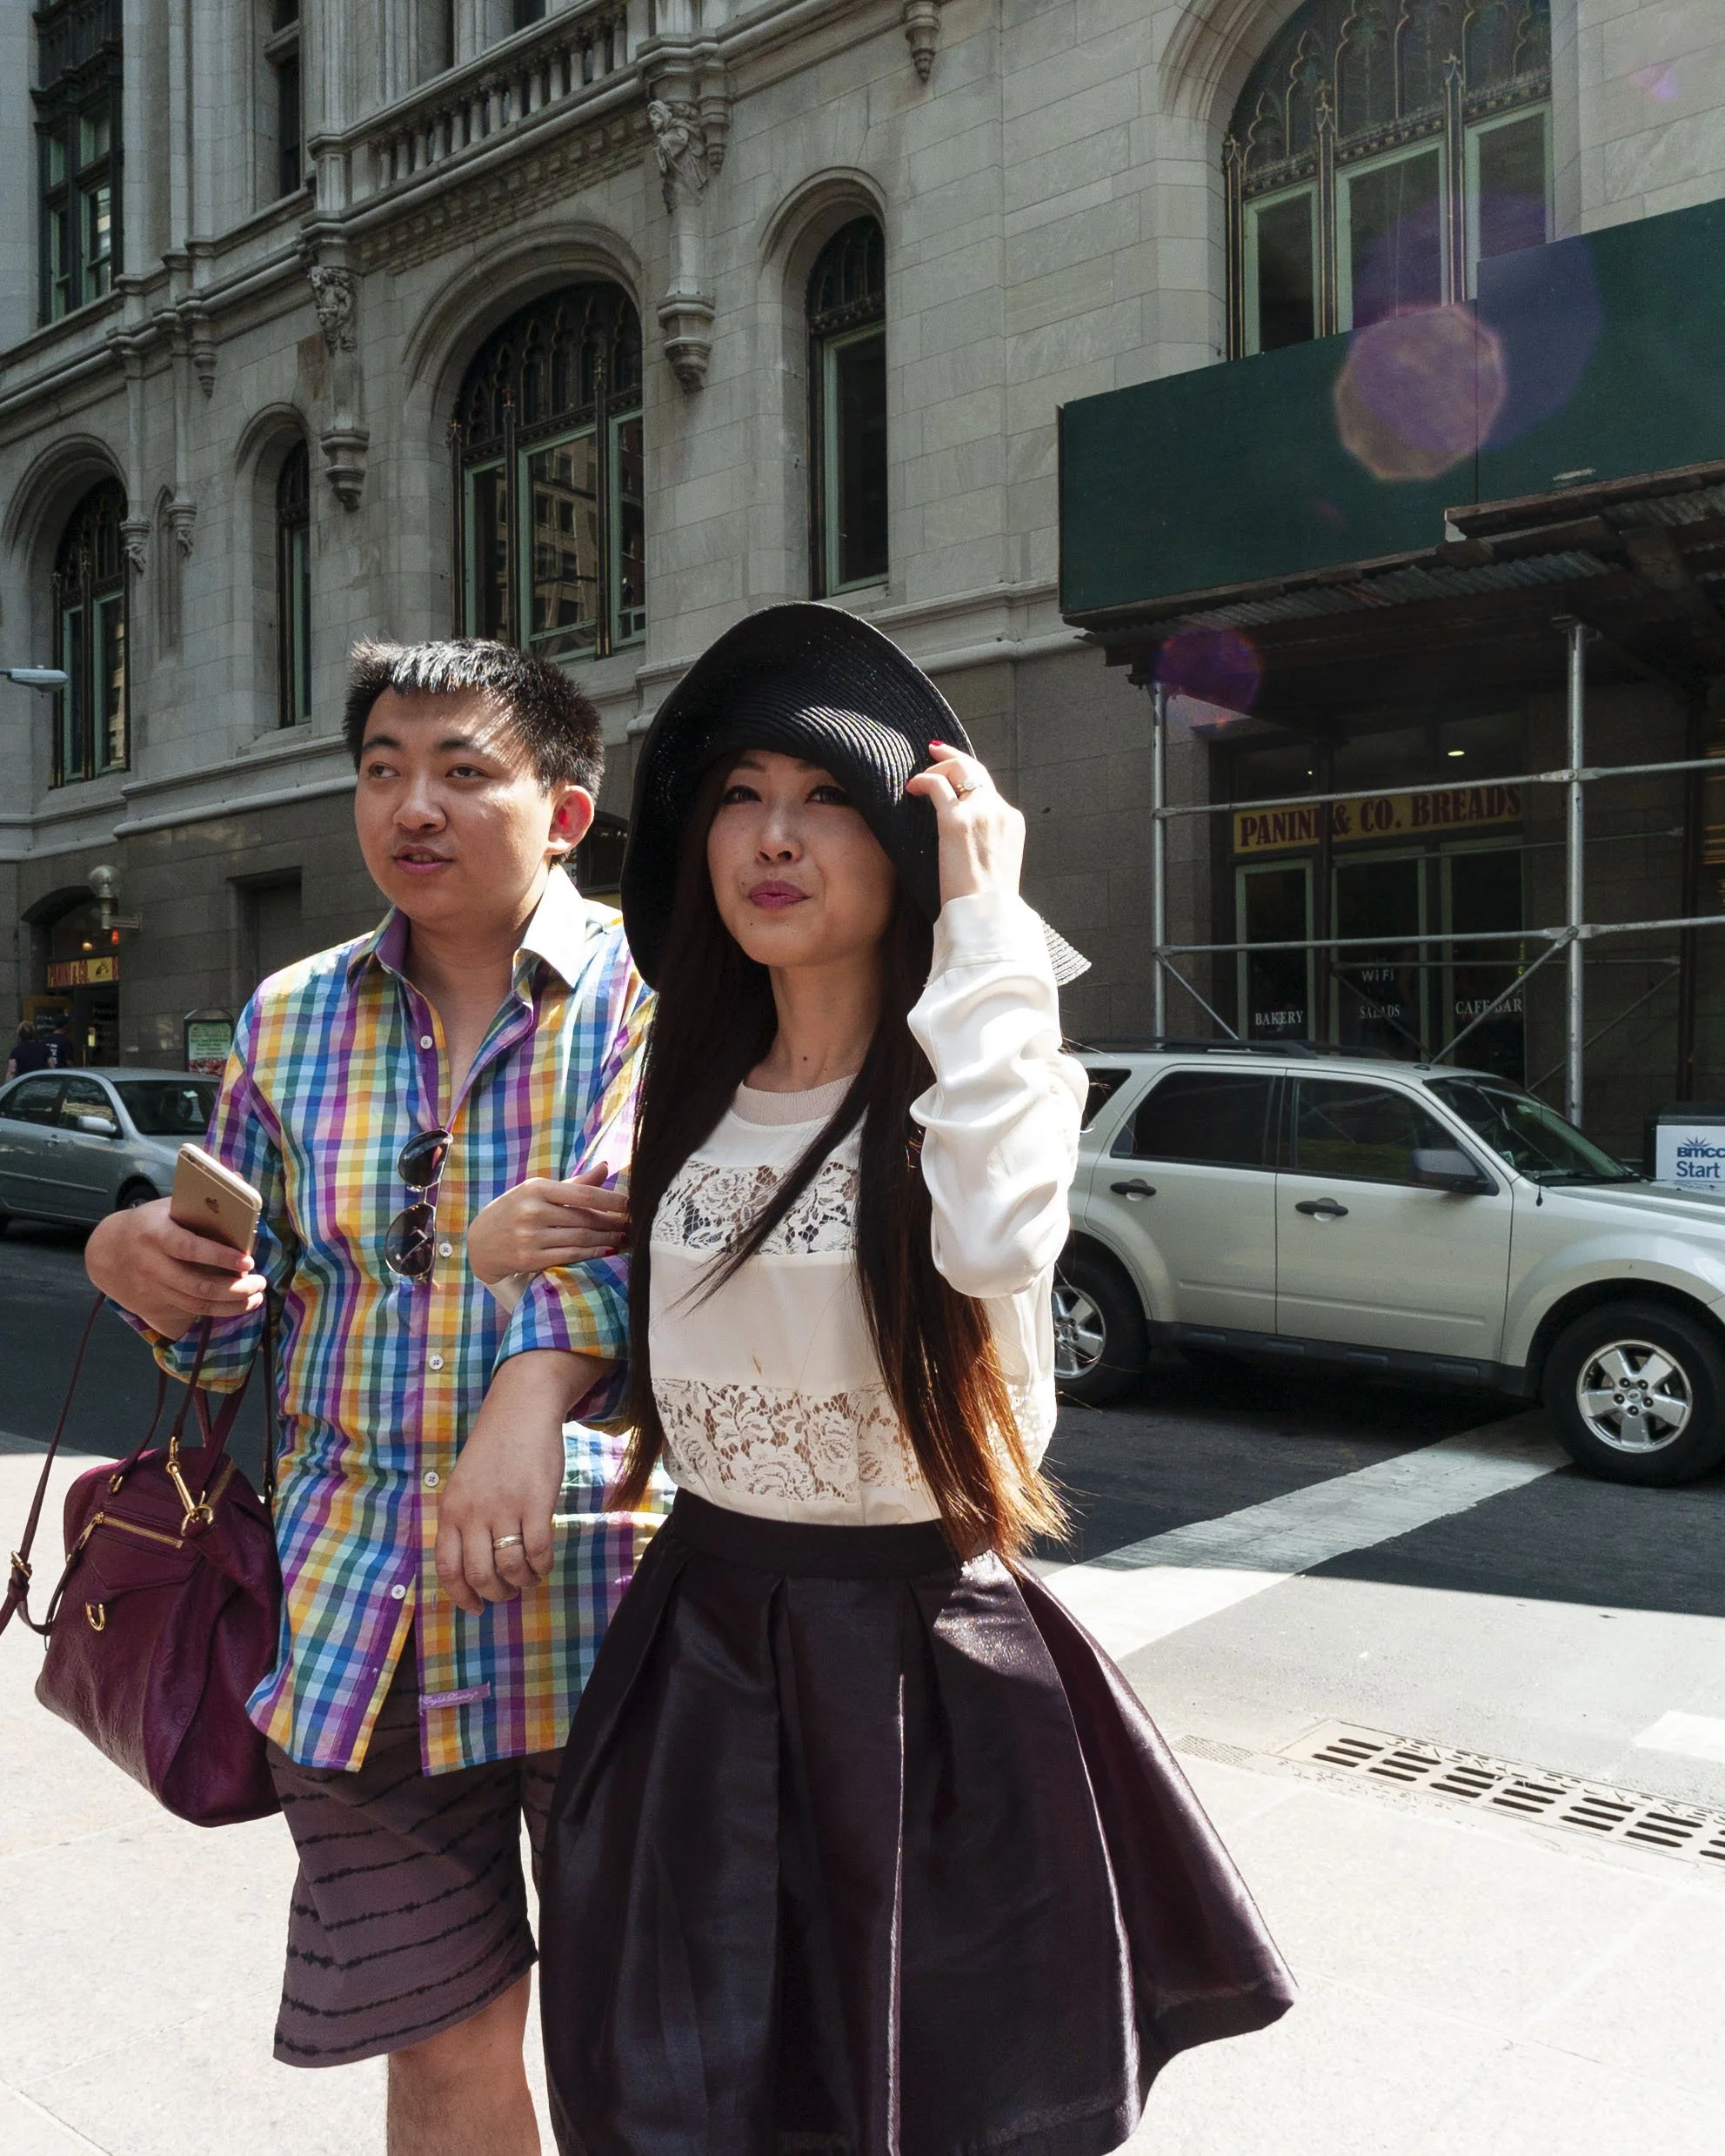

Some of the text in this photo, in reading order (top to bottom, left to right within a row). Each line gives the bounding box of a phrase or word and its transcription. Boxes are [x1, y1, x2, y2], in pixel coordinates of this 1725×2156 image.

[1240, 785, 1521, 847] PANINI & CO. BREADS
[1255, 1009, 1304, 1026] BAKERY
[1358, 1003, 1400, 1019] SALADS
[1676, 1161, 1721, 1178] Start
